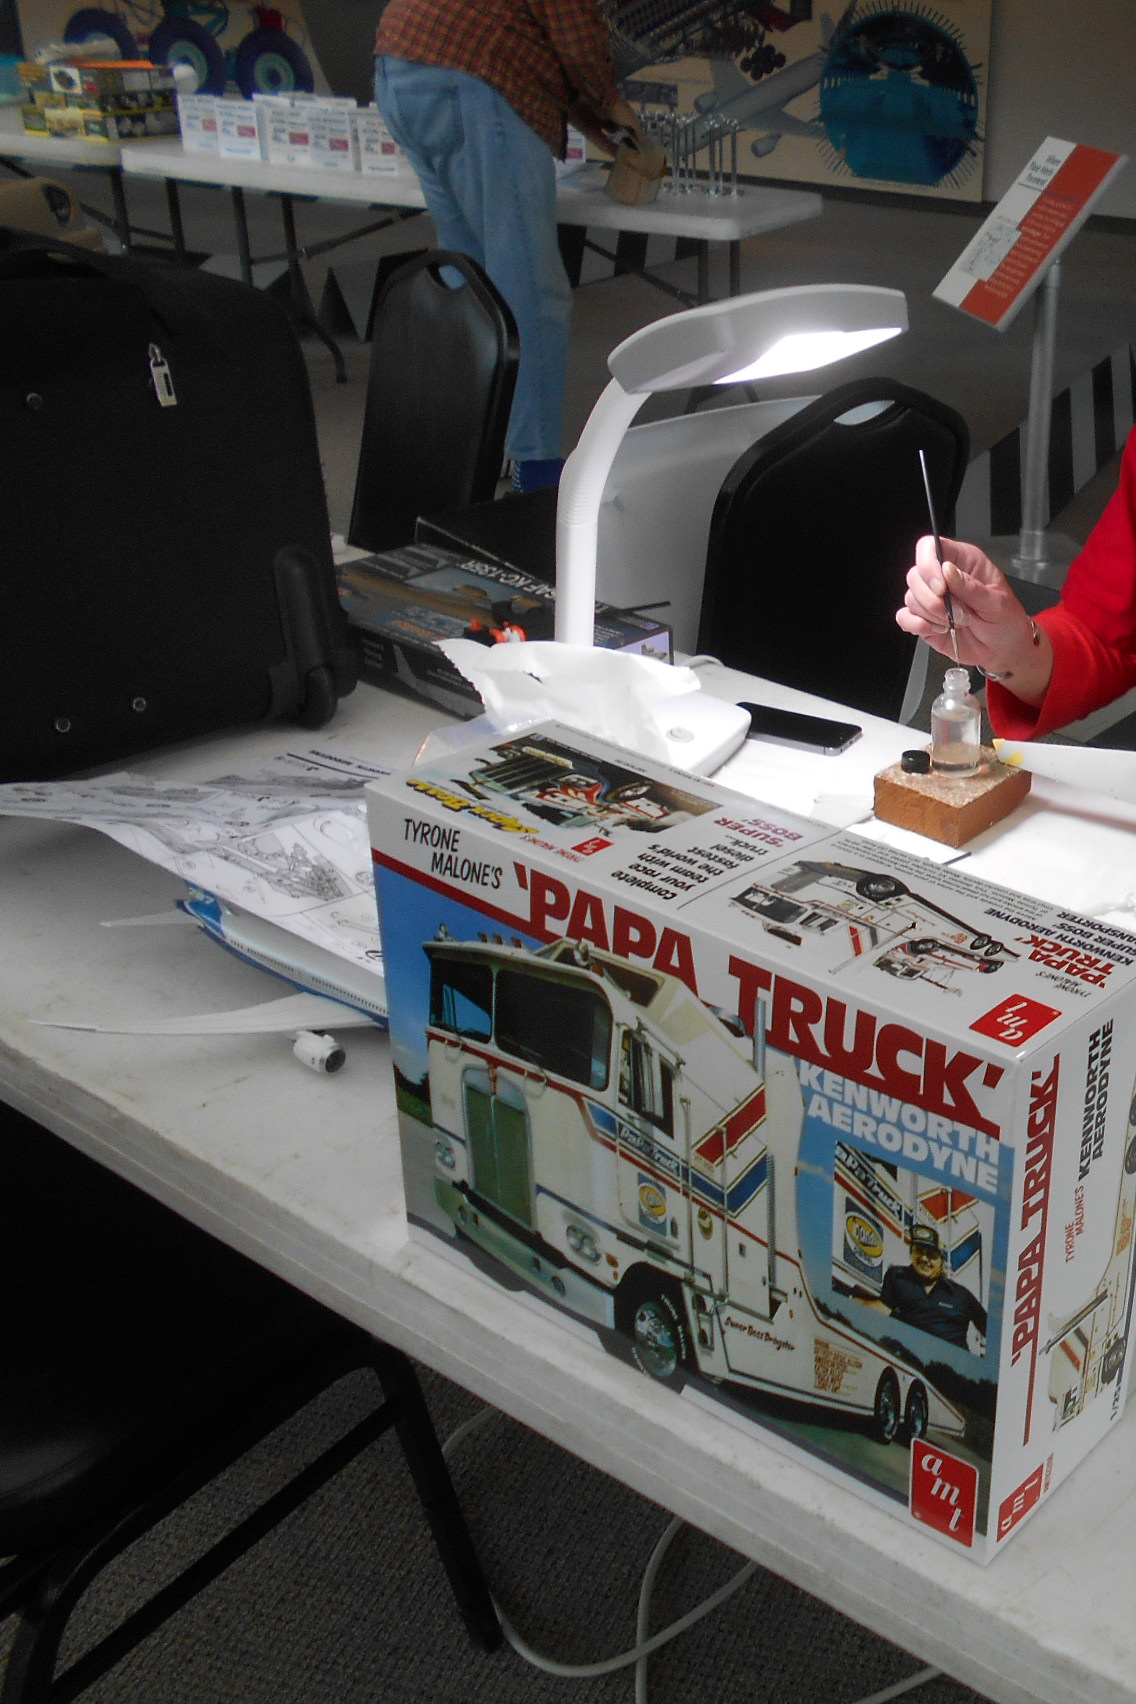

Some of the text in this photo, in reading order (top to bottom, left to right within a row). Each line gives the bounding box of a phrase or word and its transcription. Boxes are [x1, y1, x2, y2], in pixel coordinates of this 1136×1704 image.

[404, 818, 461, 852] TYRONE
[710, 843, 755, 862] diesel
[431, 852, 503, 889] MALONE'S
[629, 863, 695, 892] your race
[637, 852, 709, 884] team with
[648, 844, 724, 877] the world's
[687, 846, 740, 870] fastest
[611, 870, 678, 900] Complete
[984, 907, 1135, 966] KENWORTH AERODYNE
[513, 861, 699, 998] 'PAPA
[728, 954, 1005, 1126] TRUCK'
[1078, 1028, 1101, 1182] KENWORTH
[1092, 1018, 1114, 1160] AERODYNE
[798, 1061, 1001, 1166] KENWORTH
[806, 1093, 999, 1195] AERODYNE
[1074, 1185, 1085, 1236] MALONE'S
[1065, 1221, 1075, 1264] TYRONE
